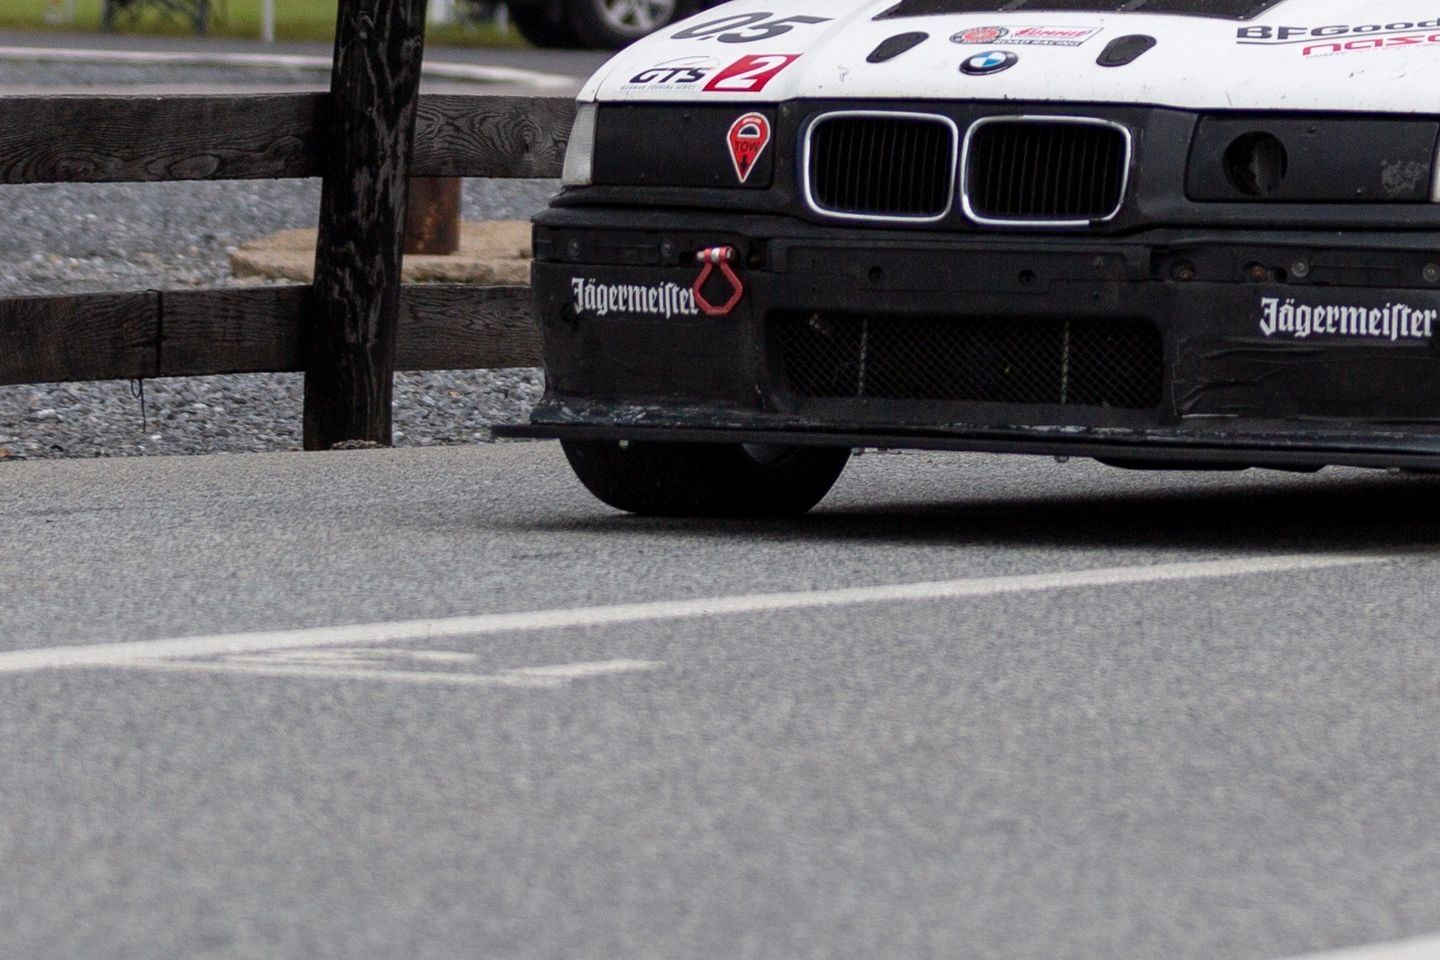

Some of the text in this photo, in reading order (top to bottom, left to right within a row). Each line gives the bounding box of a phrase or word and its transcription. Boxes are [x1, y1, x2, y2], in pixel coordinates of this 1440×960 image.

[629, 55, 788, 88] GTS 2
[734, 141, 759, 153] TOW
